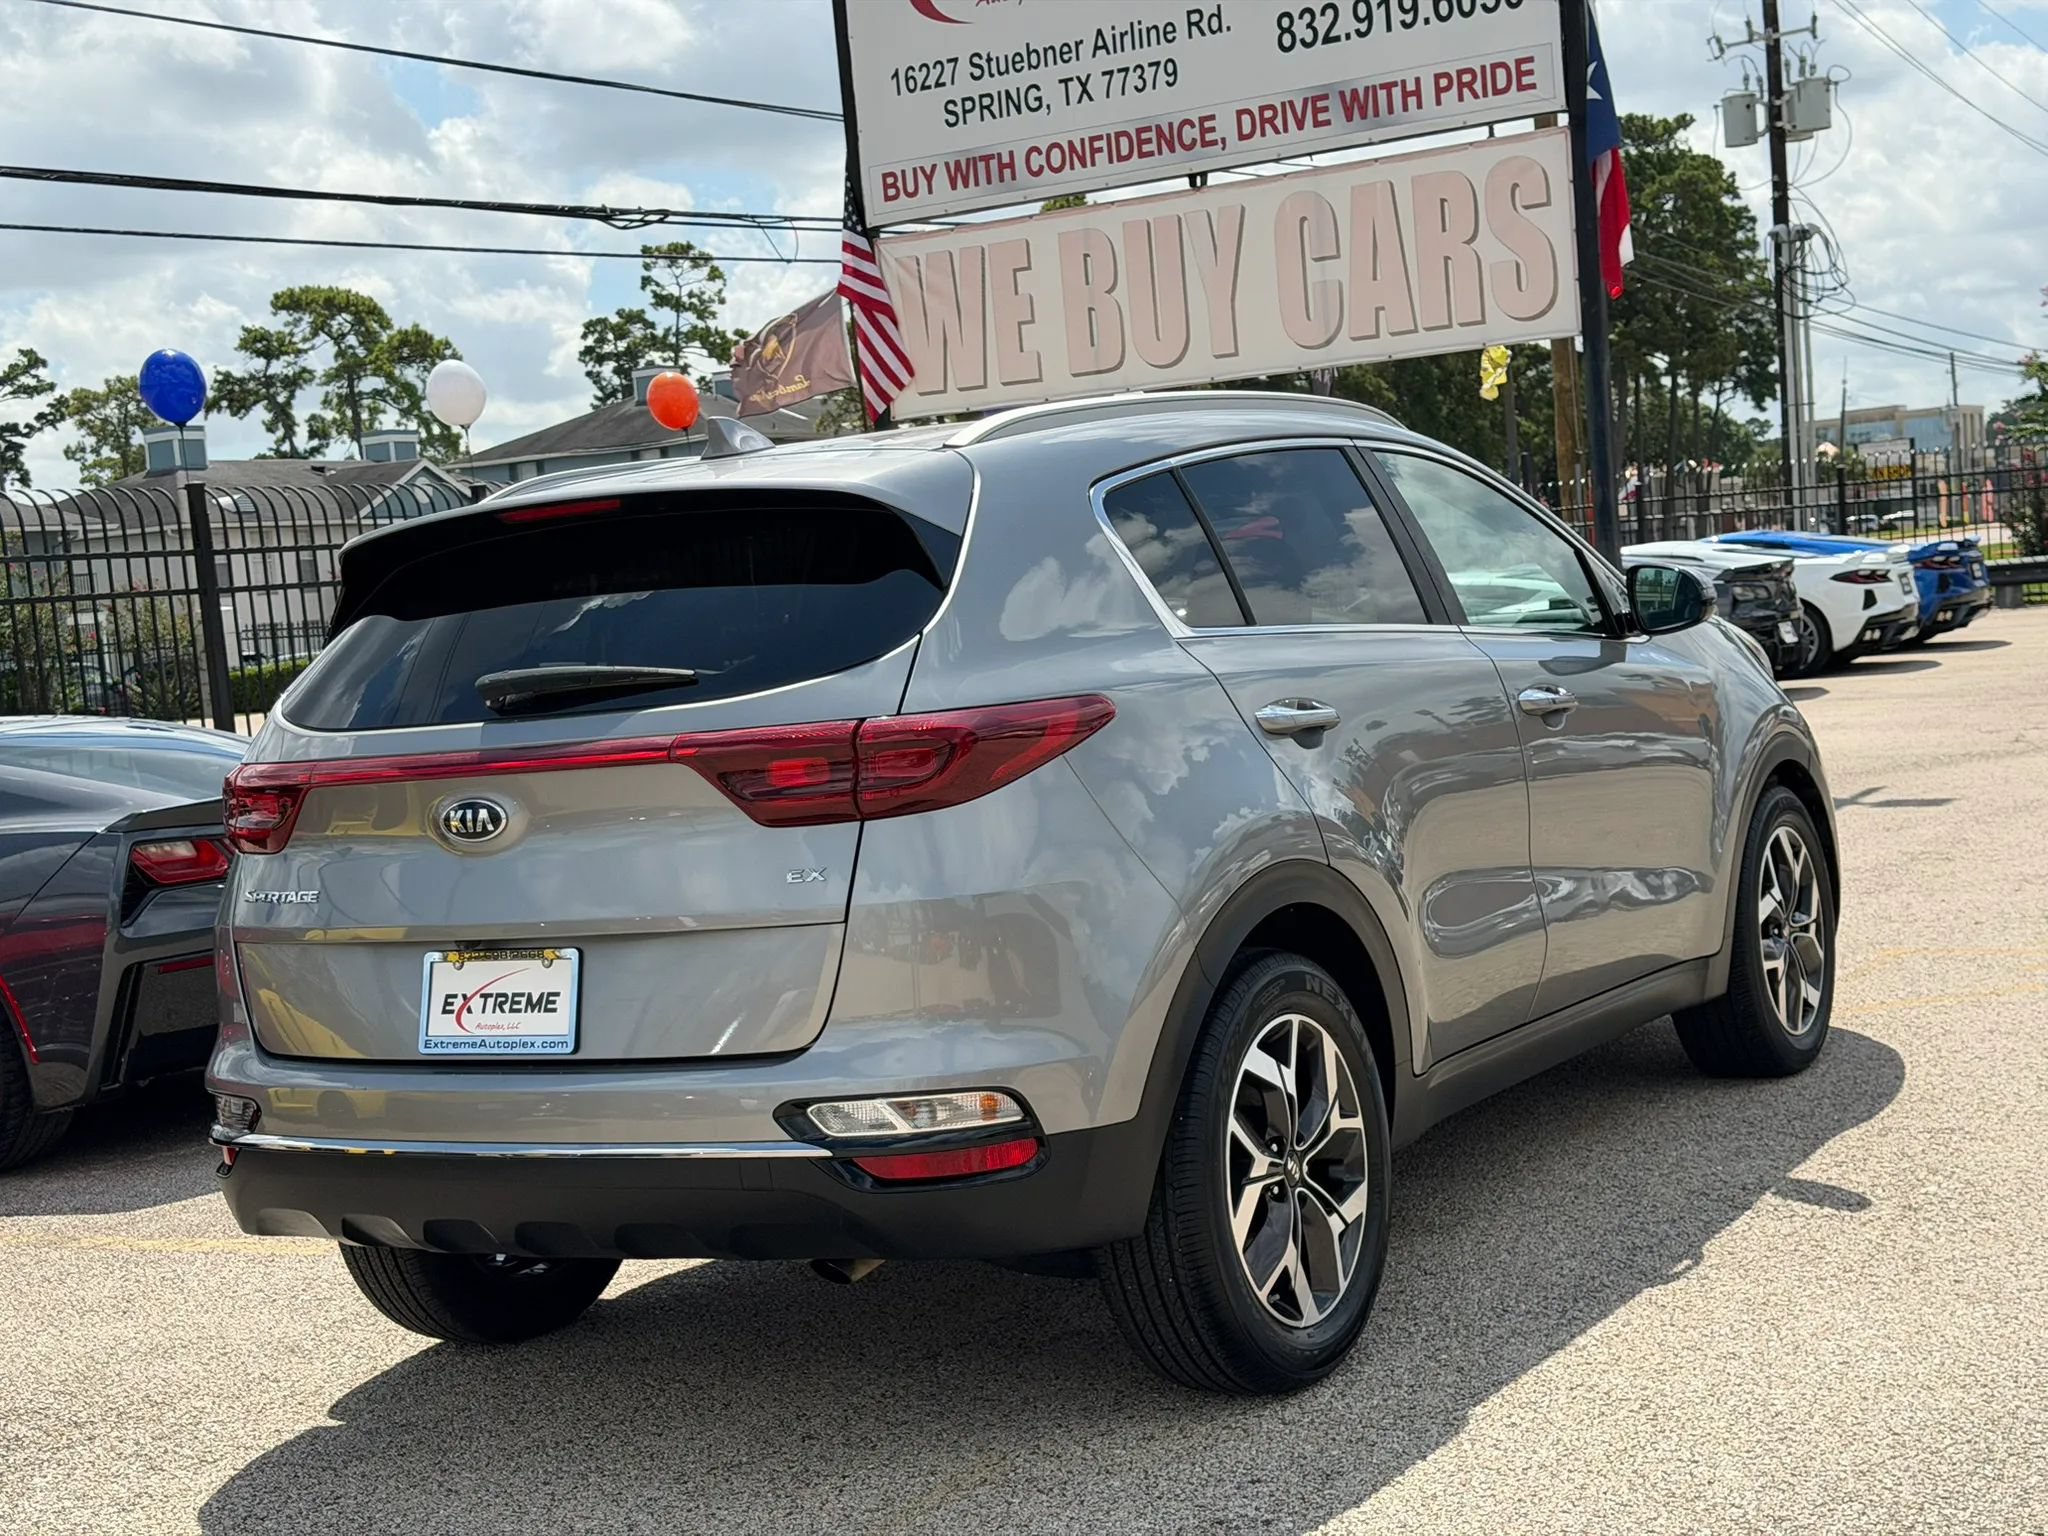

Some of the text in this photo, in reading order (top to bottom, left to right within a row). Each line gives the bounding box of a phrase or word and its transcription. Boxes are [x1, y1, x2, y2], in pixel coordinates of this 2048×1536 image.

[1277, 0, 1525, 53] 832.919.6
[890, 3, 1232, 96] 16227 Stuebner Airline Rd.
[943, 57, 1178, 128] SPRING, TX 77379
[881, 55, 1538, 202] BUY WITH CONFIDENCE, DRIVE WITH PRIDE
[895, 155, 1560, 397] WE BUY CARS
[449, 808, 495, 833] KIA
[786, 867, 827, 884] EX
[244, 889, 320, 904] SPORTAGE
[440, 991, 562, 1015] EXTREME
[423, 1038, 569, 1050] ExtremeAutoplex.com
